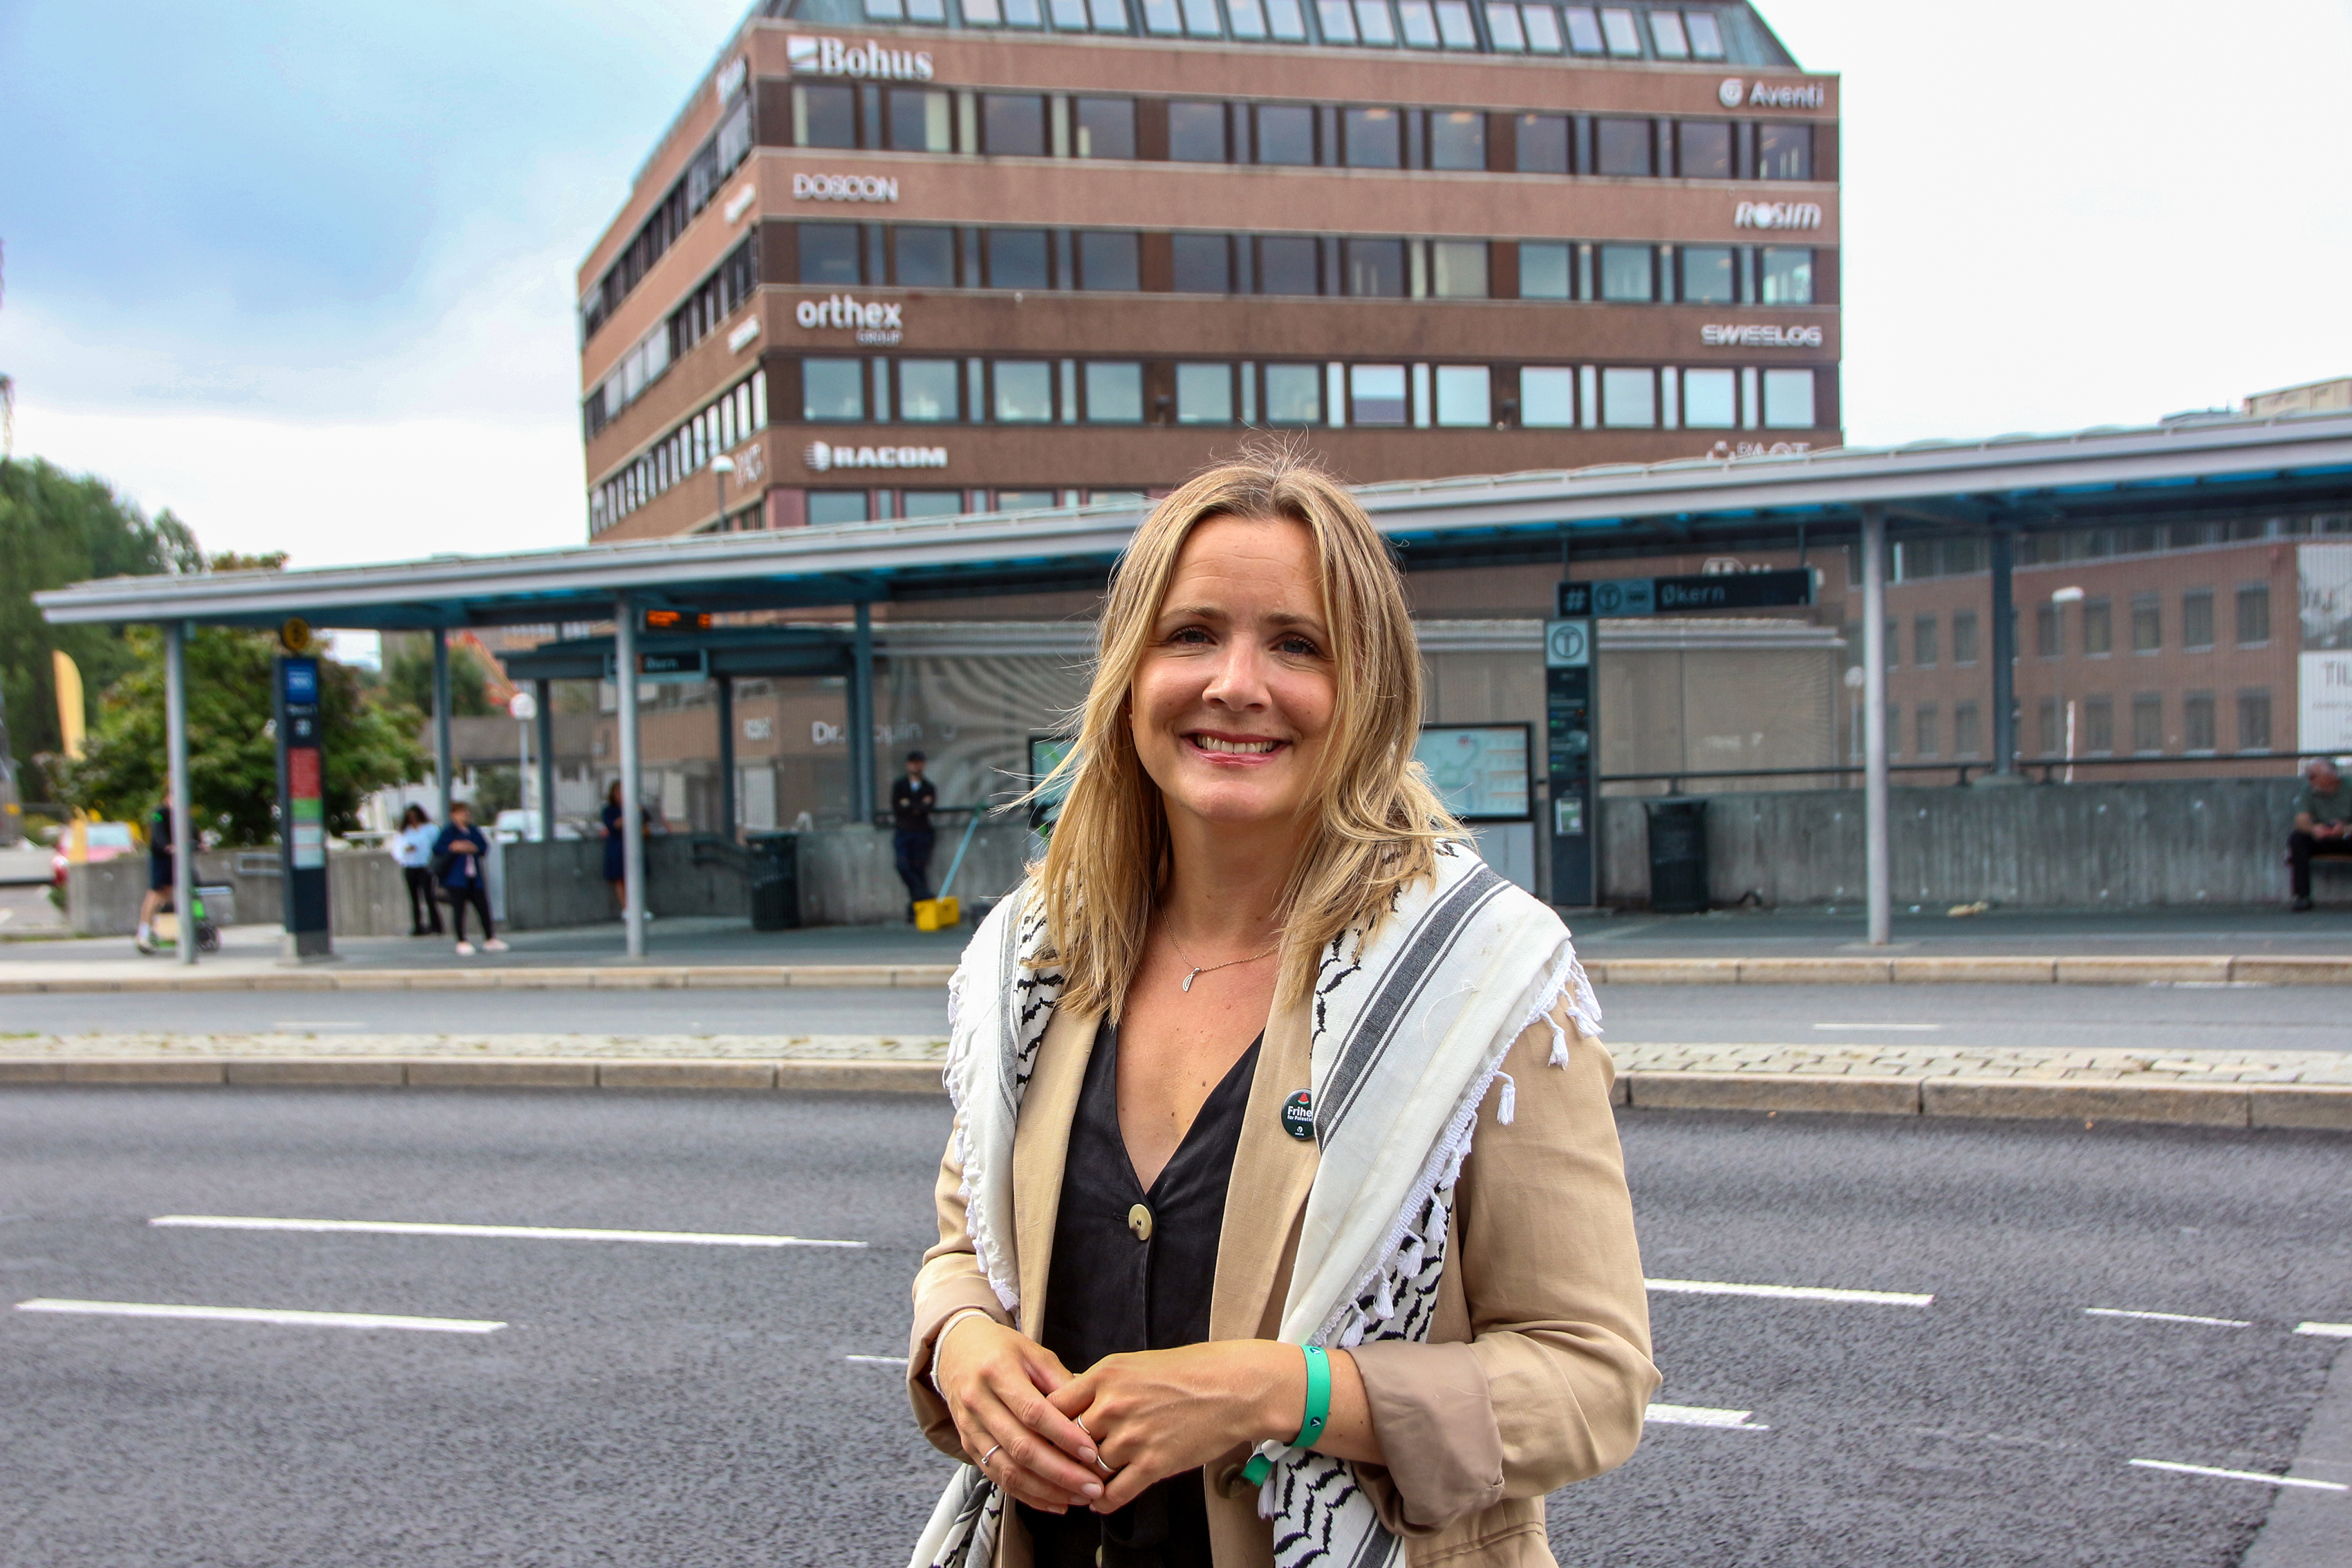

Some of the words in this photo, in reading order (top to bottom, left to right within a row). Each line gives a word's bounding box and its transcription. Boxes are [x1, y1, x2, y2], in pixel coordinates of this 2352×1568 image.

[820, 37, 933, 81] Bohus
[1750, 81, 1824, 106] Aventi
[793, 174, 898, 202] DOSCON
[796, 294, 902, 328] orthex
[833, 446, 948, 468] RACOM
[1661, 584, 1726, 606] Økern
[1287, 1105, 1312, 1117] Frihe
